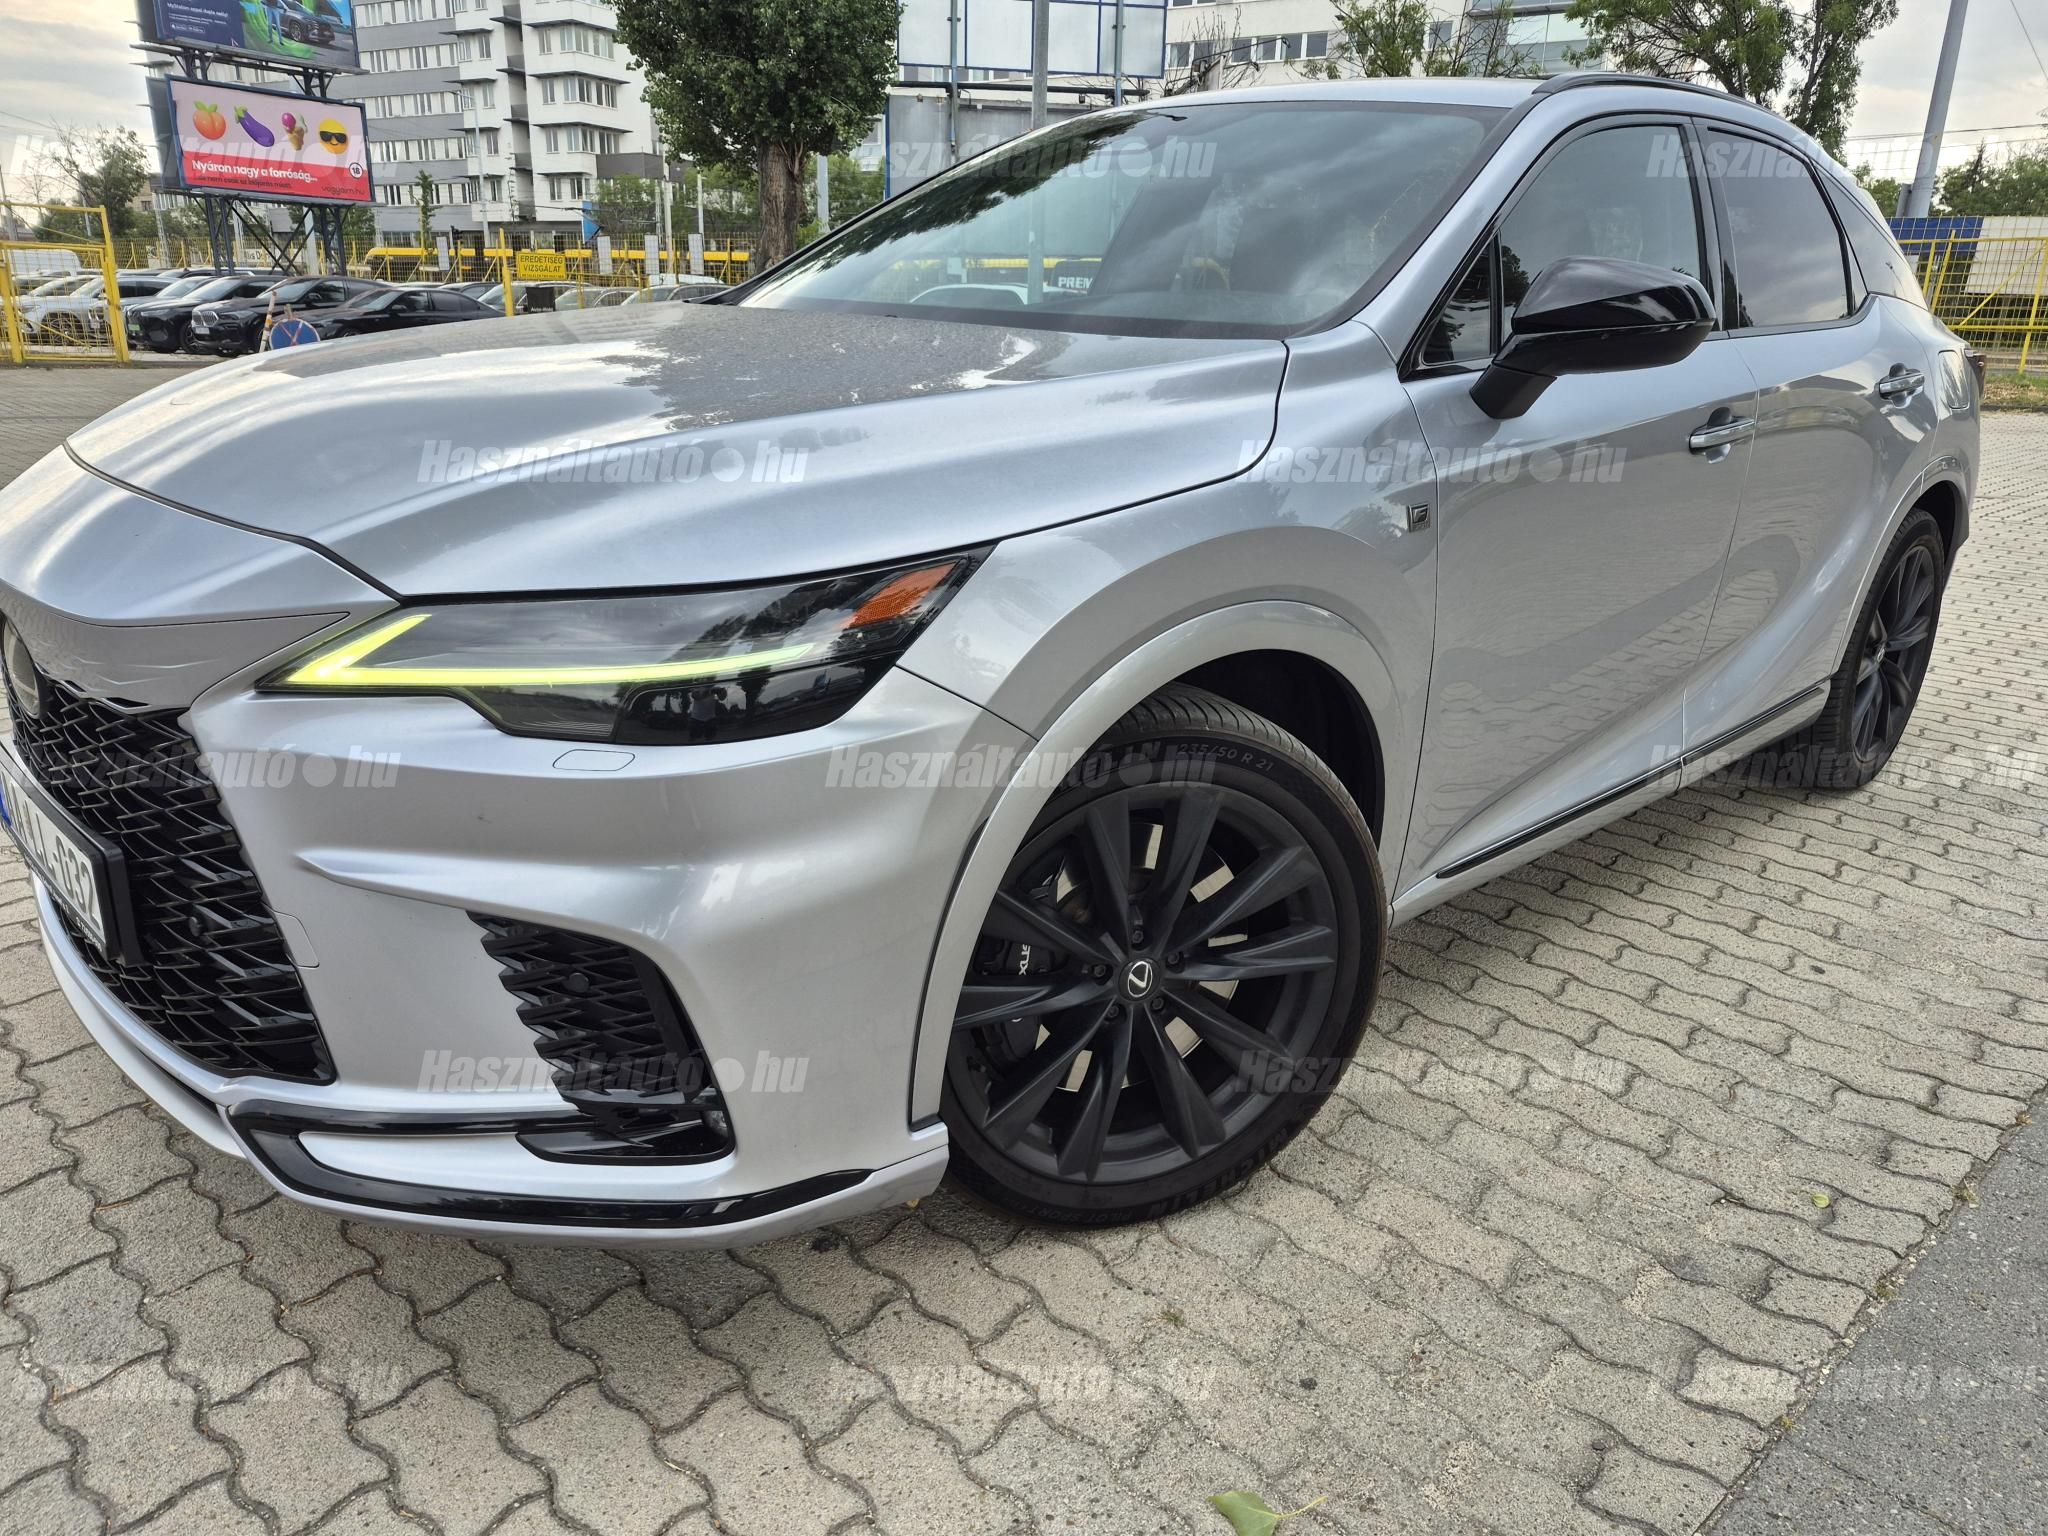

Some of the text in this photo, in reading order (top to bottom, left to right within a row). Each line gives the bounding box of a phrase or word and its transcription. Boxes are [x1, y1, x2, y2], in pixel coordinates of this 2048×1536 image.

[192, 160, 232, 174] Nyáron
[233, 166, 259, 178] nagy
[352, 167, 361, 175] 18
